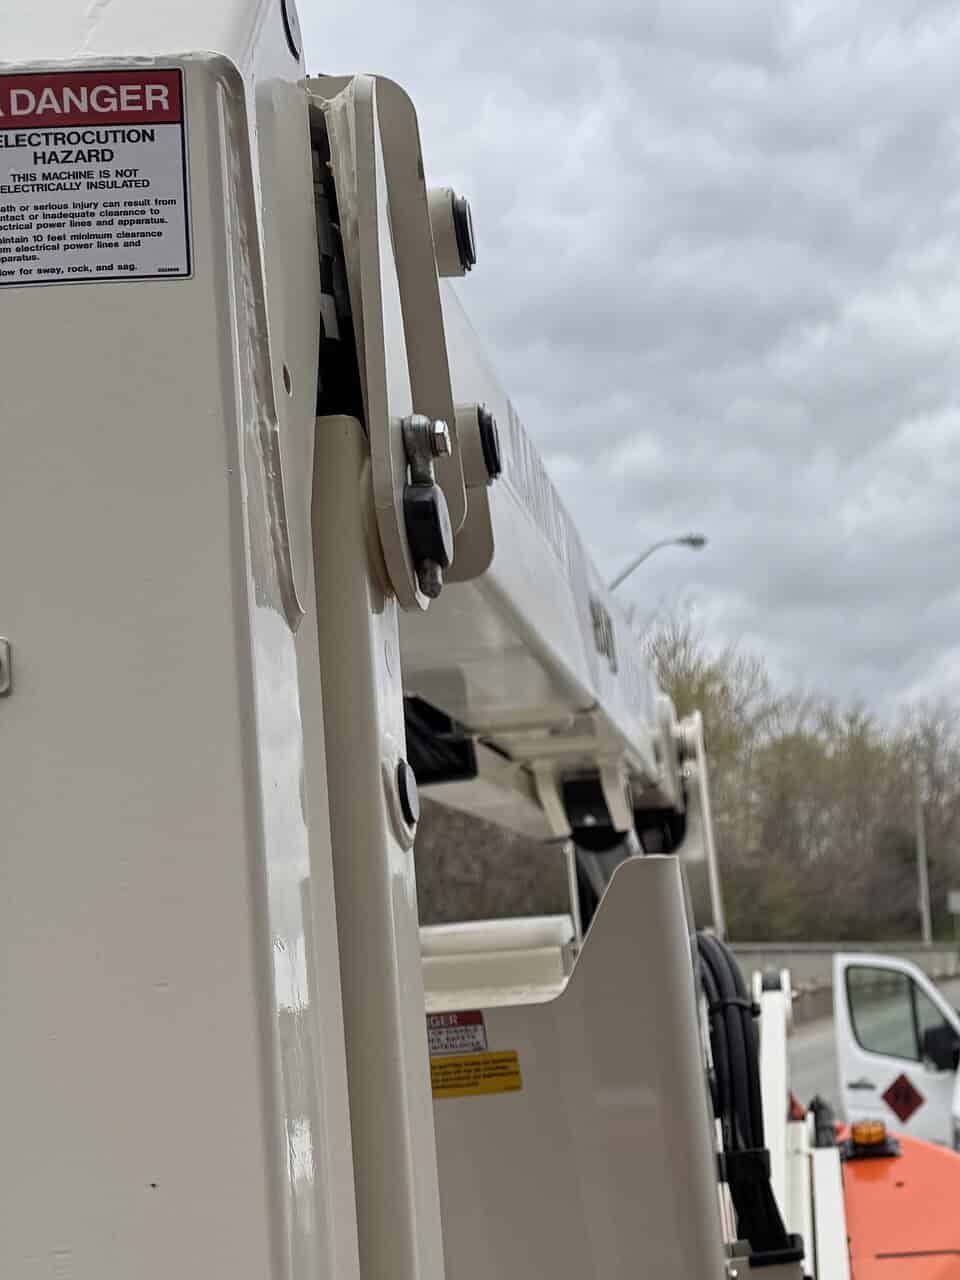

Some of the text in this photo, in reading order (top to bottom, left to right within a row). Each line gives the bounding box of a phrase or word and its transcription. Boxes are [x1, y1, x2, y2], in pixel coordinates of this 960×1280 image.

[10, 84, 169, 116] DANGER
[33, 149, 114, 165] HAZARD
[10, 168, 139, 182] THIS MACHINE IS NOT
[0, 179, 150, 193] ELECTRICALLY INSULATED
[34, 202, 69, 210] serious
[72, 200, 99, 210] injury
[124, 199, 151, 207] result
[155, 198, 176, 206] from
[43, 211, 96, 221] inadequate
[100, 209, 146, 217] clearance
[36, 222, 66, 230] power
[70, 220, 92, 228] lines
[33, 234, 44, 242] 10
[70, 232, 113, 241] minimum
[116, 231, 162, 239] clearance
[16, 243, 60, 253] electrical
[63, 243, 94, 251] power
[97, 241, 120, 249] lines
[0, 254, 40, 264] paratus.
[20, 267, 33, 275] for
[96, 264, 114, 272] and
